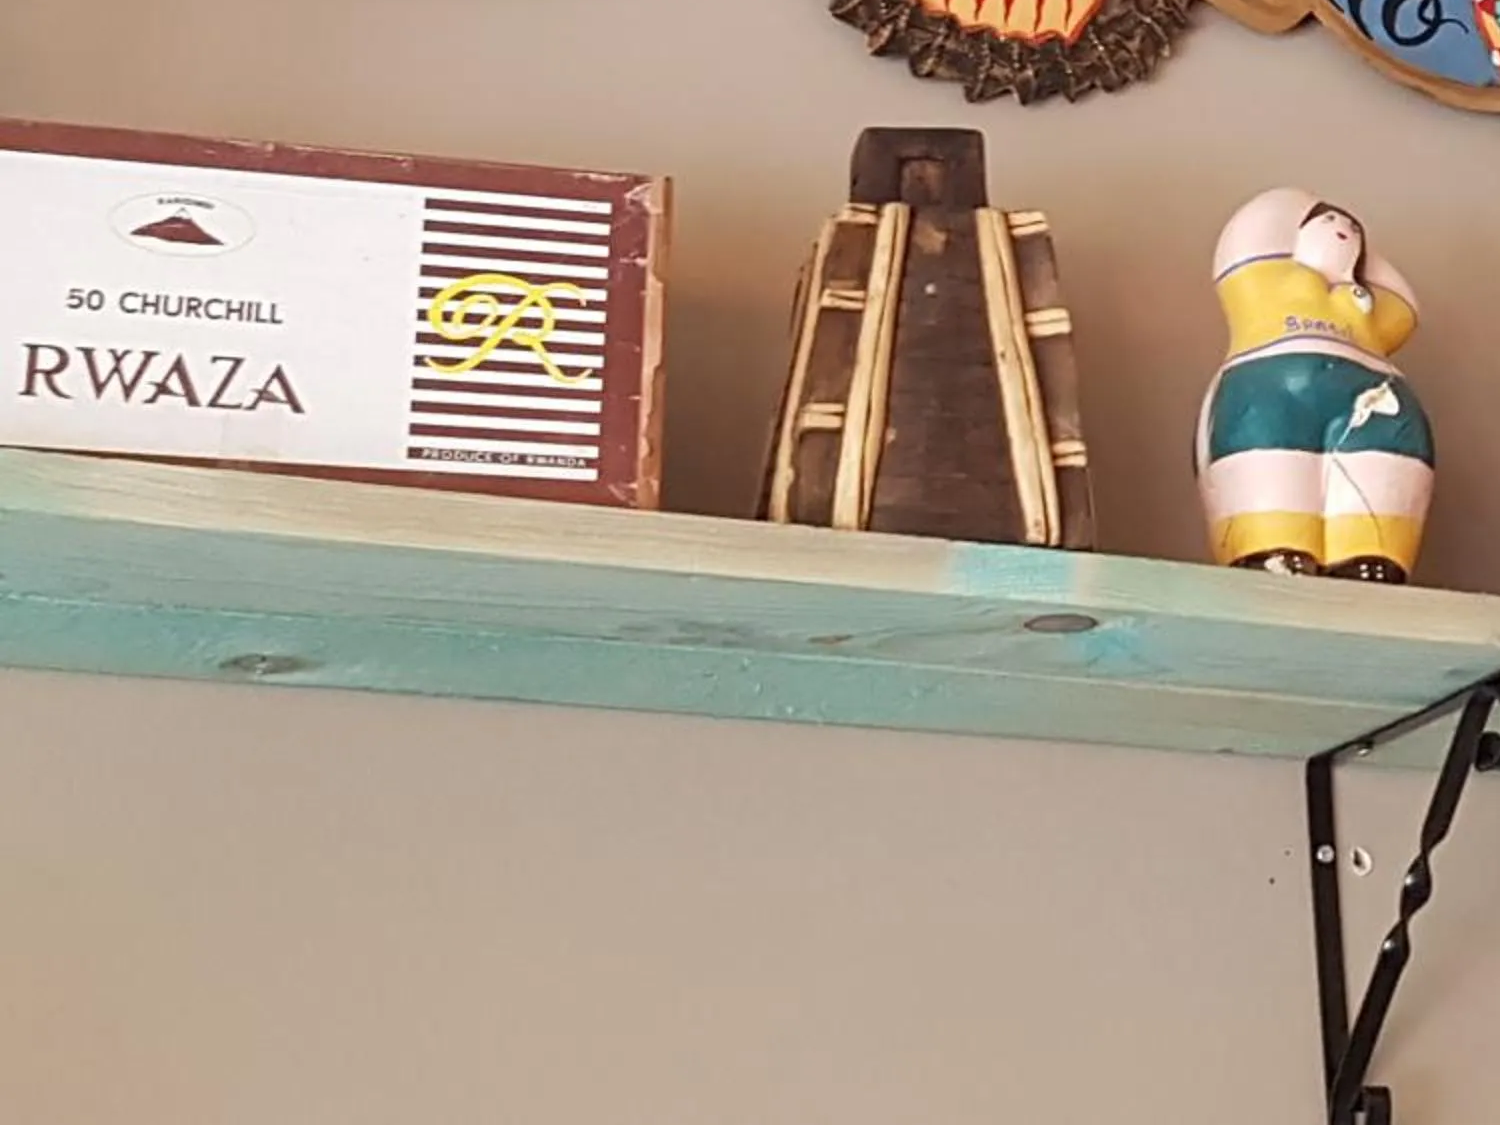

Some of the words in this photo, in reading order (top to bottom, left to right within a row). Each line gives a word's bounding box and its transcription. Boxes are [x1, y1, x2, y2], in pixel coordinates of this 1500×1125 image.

[66, 288, 105, 311] 50
[118, 291, 283, 324] CHURCHILL
[18, 343, 305, 414] RWAZA
[421, 448, 493, 463] PRODUCE
[499, 453, 519, 464] OF
[525, 456, 587, 468] RWANDA
